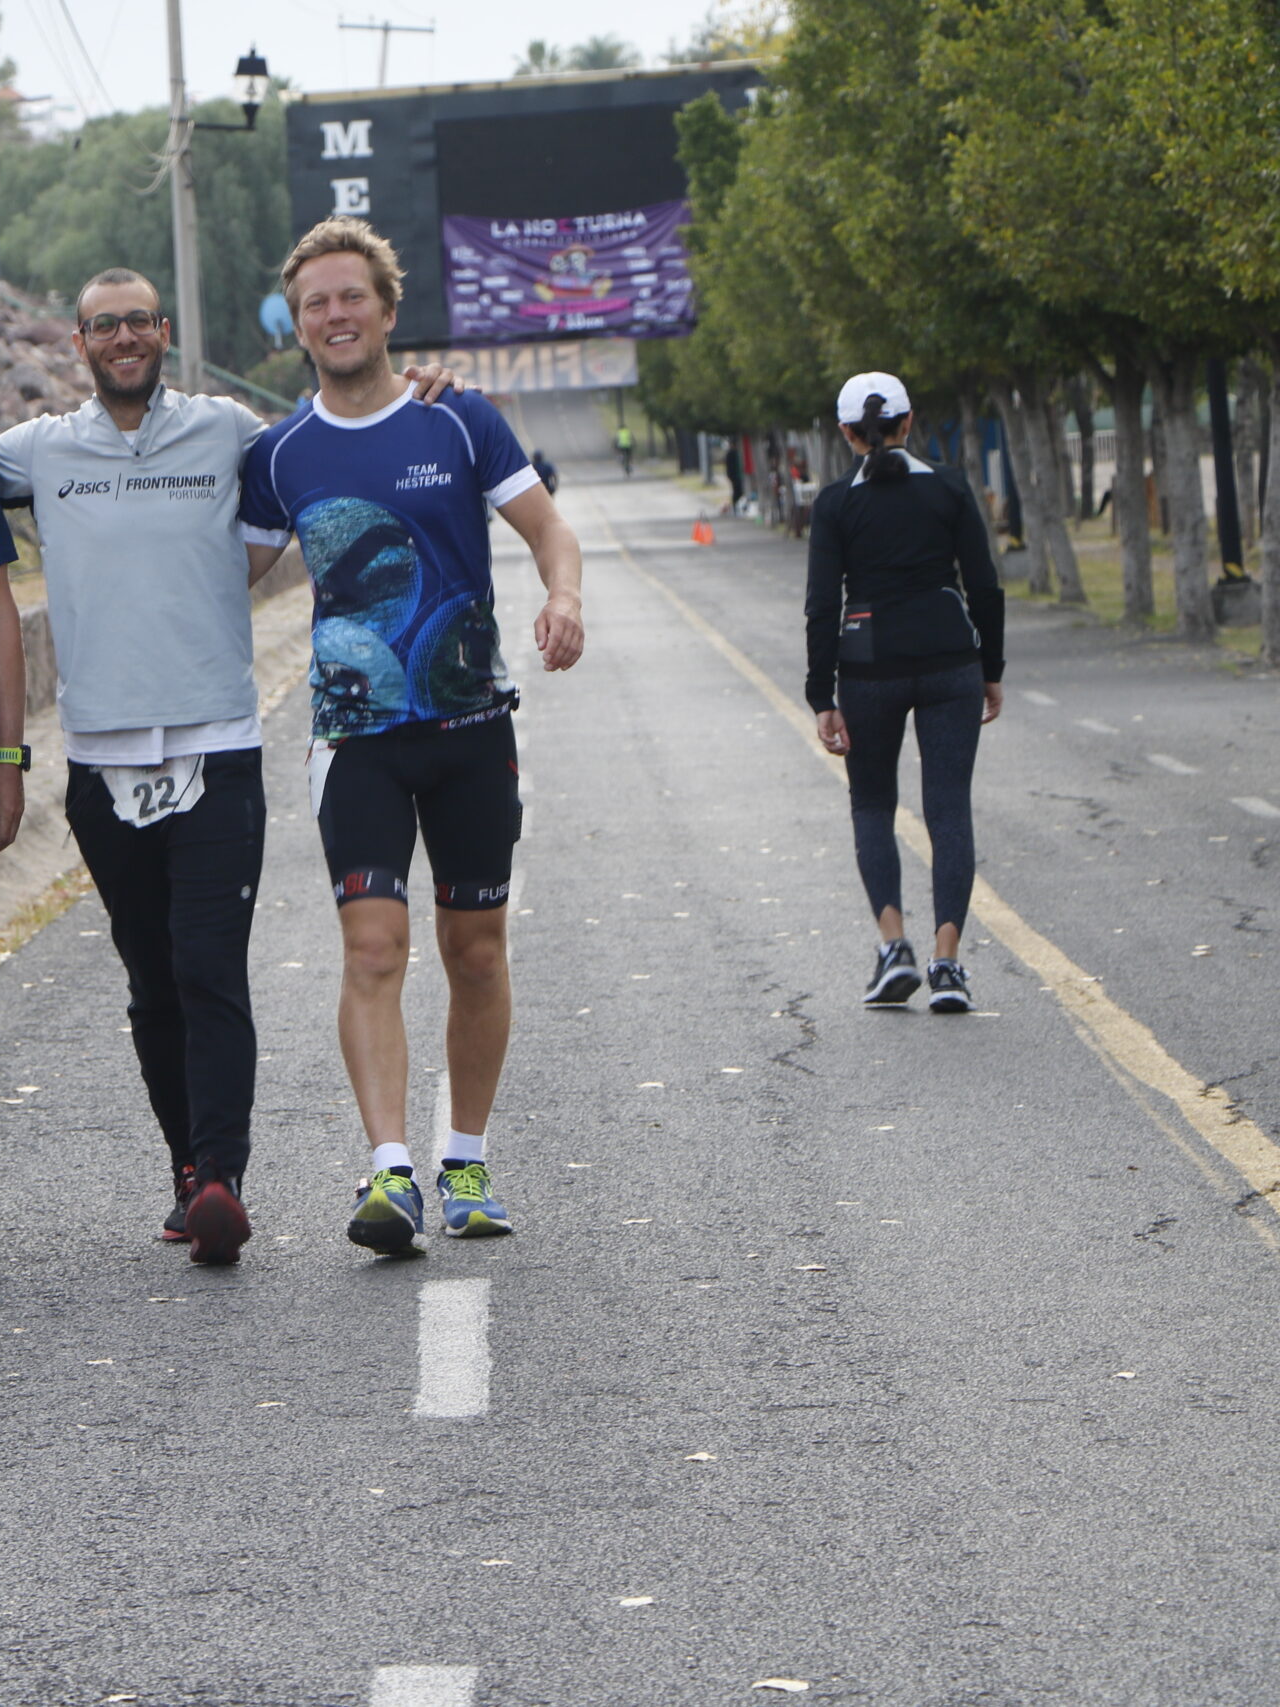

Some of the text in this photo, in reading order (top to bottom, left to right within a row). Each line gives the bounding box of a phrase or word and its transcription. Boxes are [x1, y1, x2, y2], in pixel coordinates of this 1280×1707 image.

[490, 220, 520, 239] LA
[406, 462, 438, 477] TEAM
[126, 474, 217, 491] FRONTRUNNER
[395, 472, 452, 491] HESTEPER
[169, 488, 217, 501] PORTUGAL
[132, 776, 181, 819] 22
